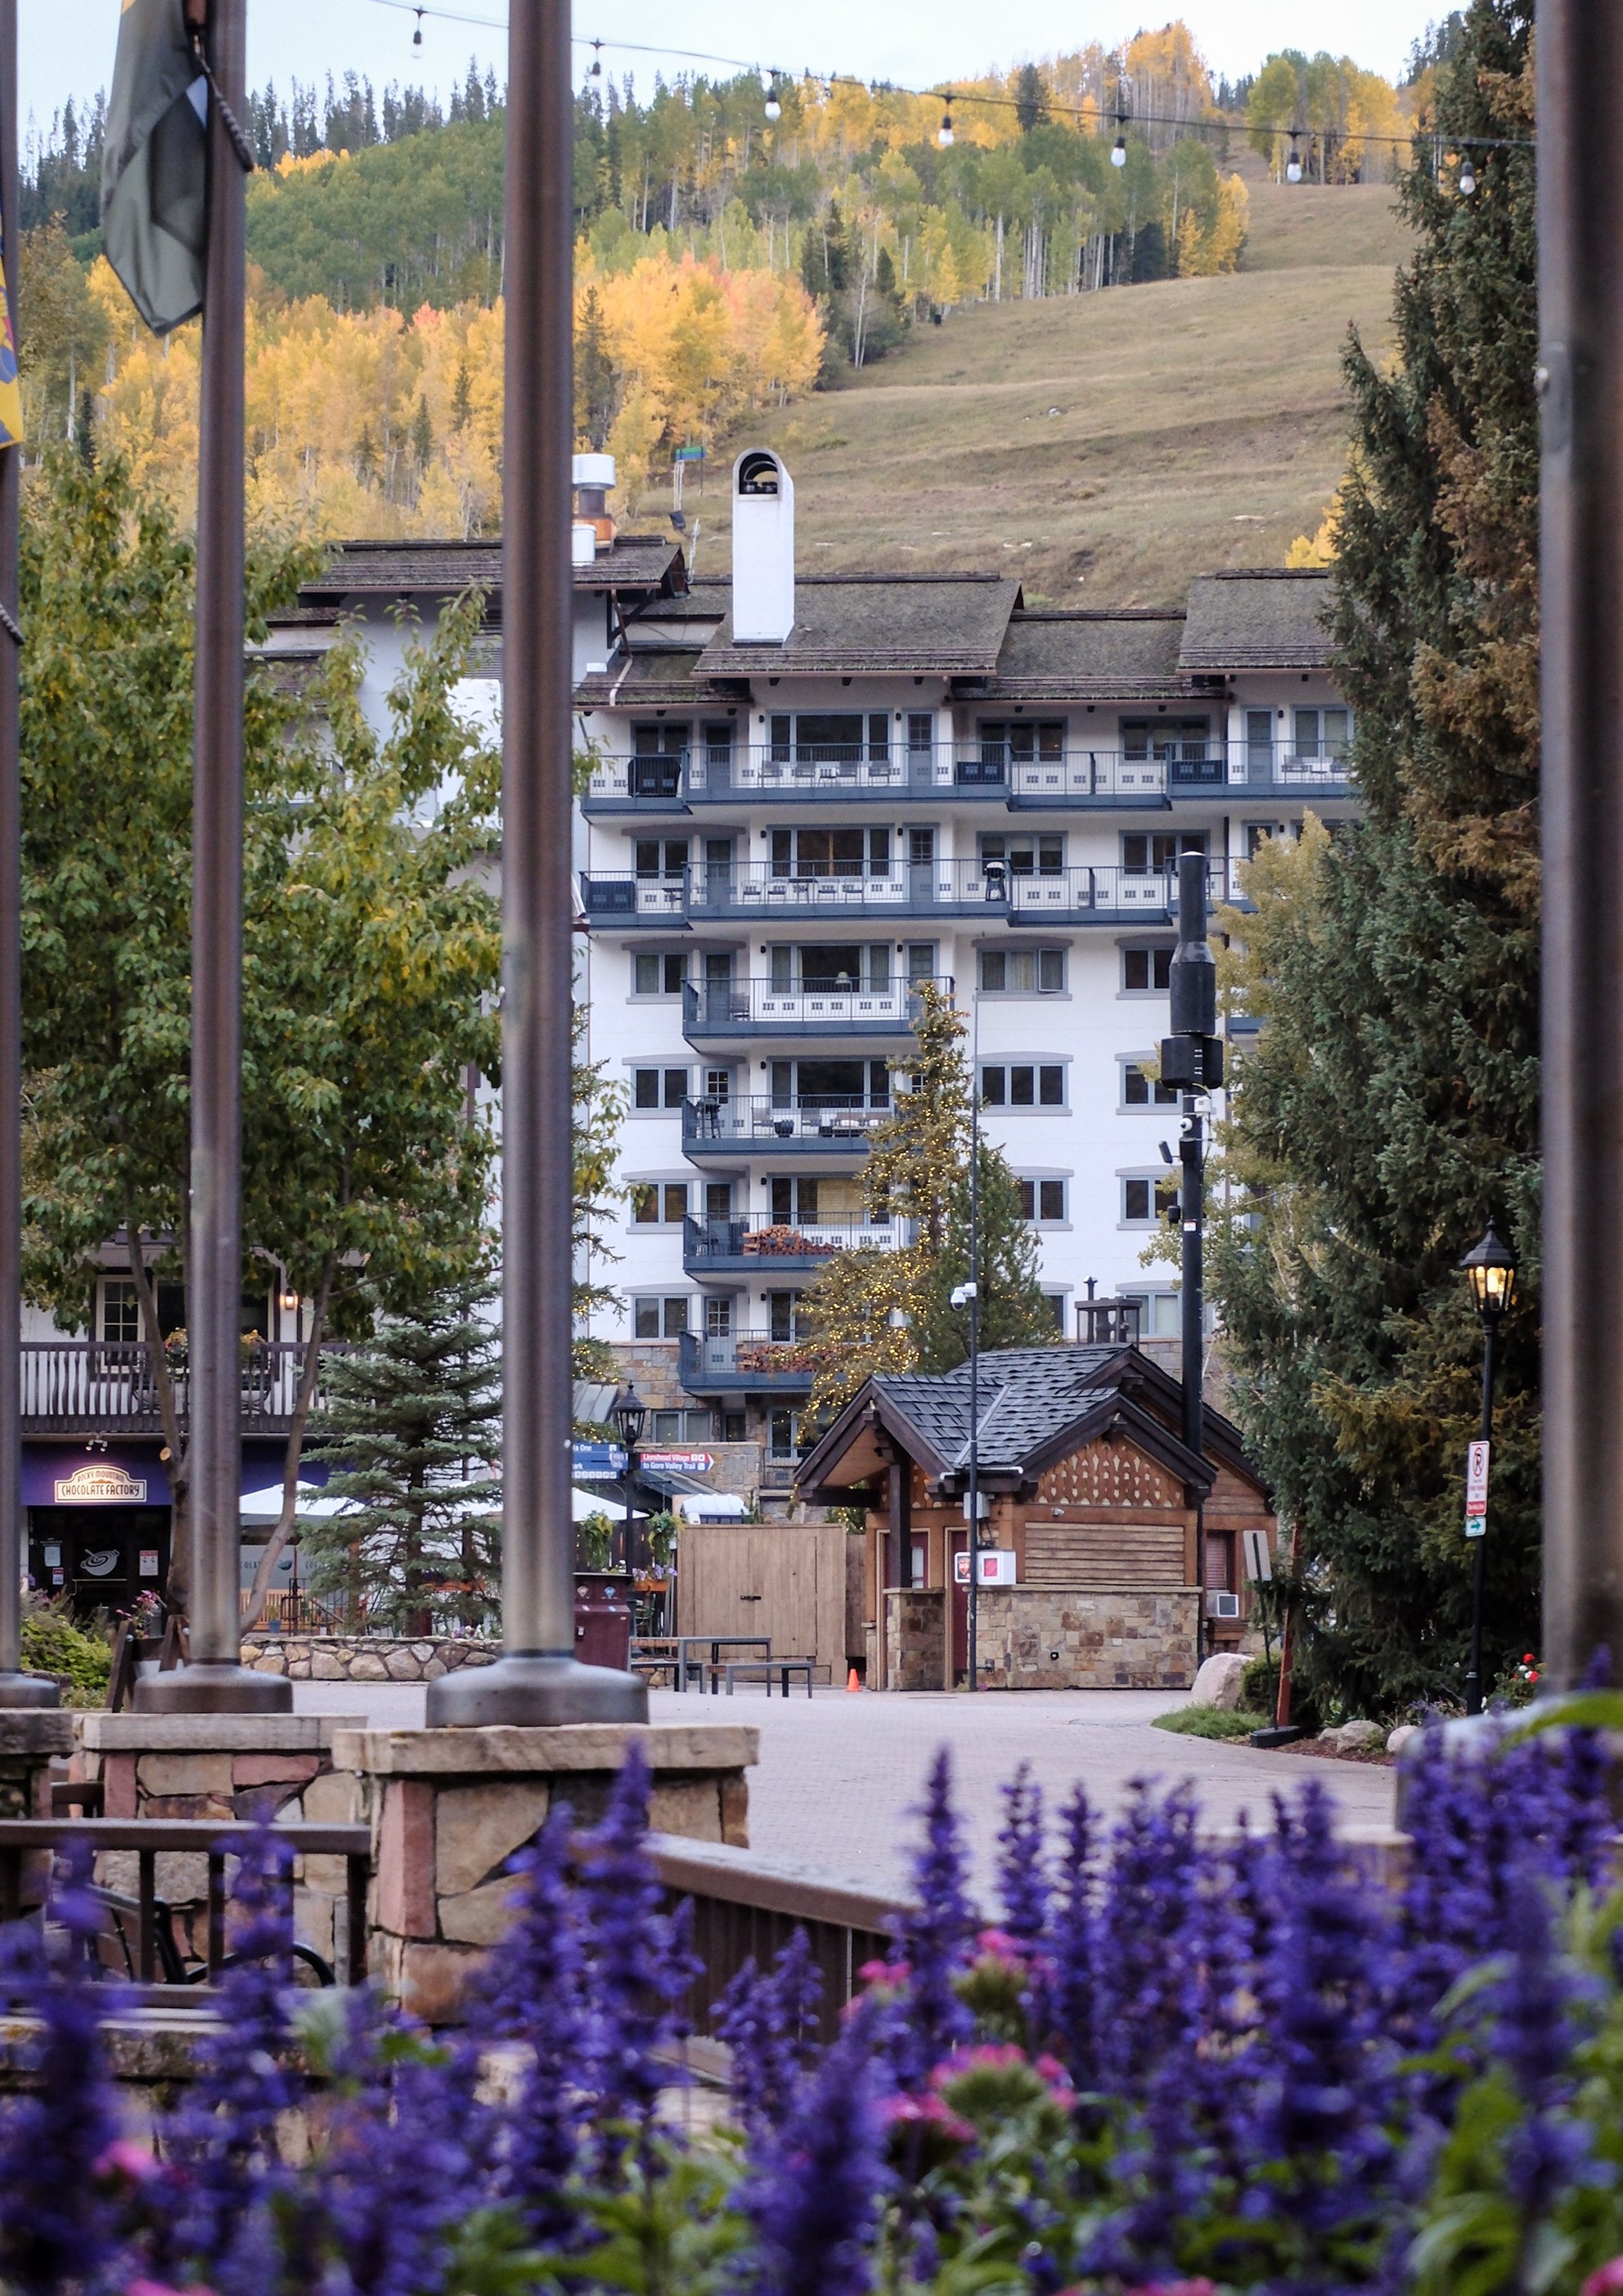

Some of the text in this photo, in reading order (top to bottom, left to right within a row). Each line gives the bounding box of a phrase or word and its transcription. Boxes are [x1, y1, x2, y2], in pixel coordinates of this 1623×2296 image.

[665, 1463, 683, 1471] Valley
[77, 1471, 125, 1483] ROCKY MOUNTAIN
[61, 1485, 140, 1497] CHOCOLATE FACTORY
